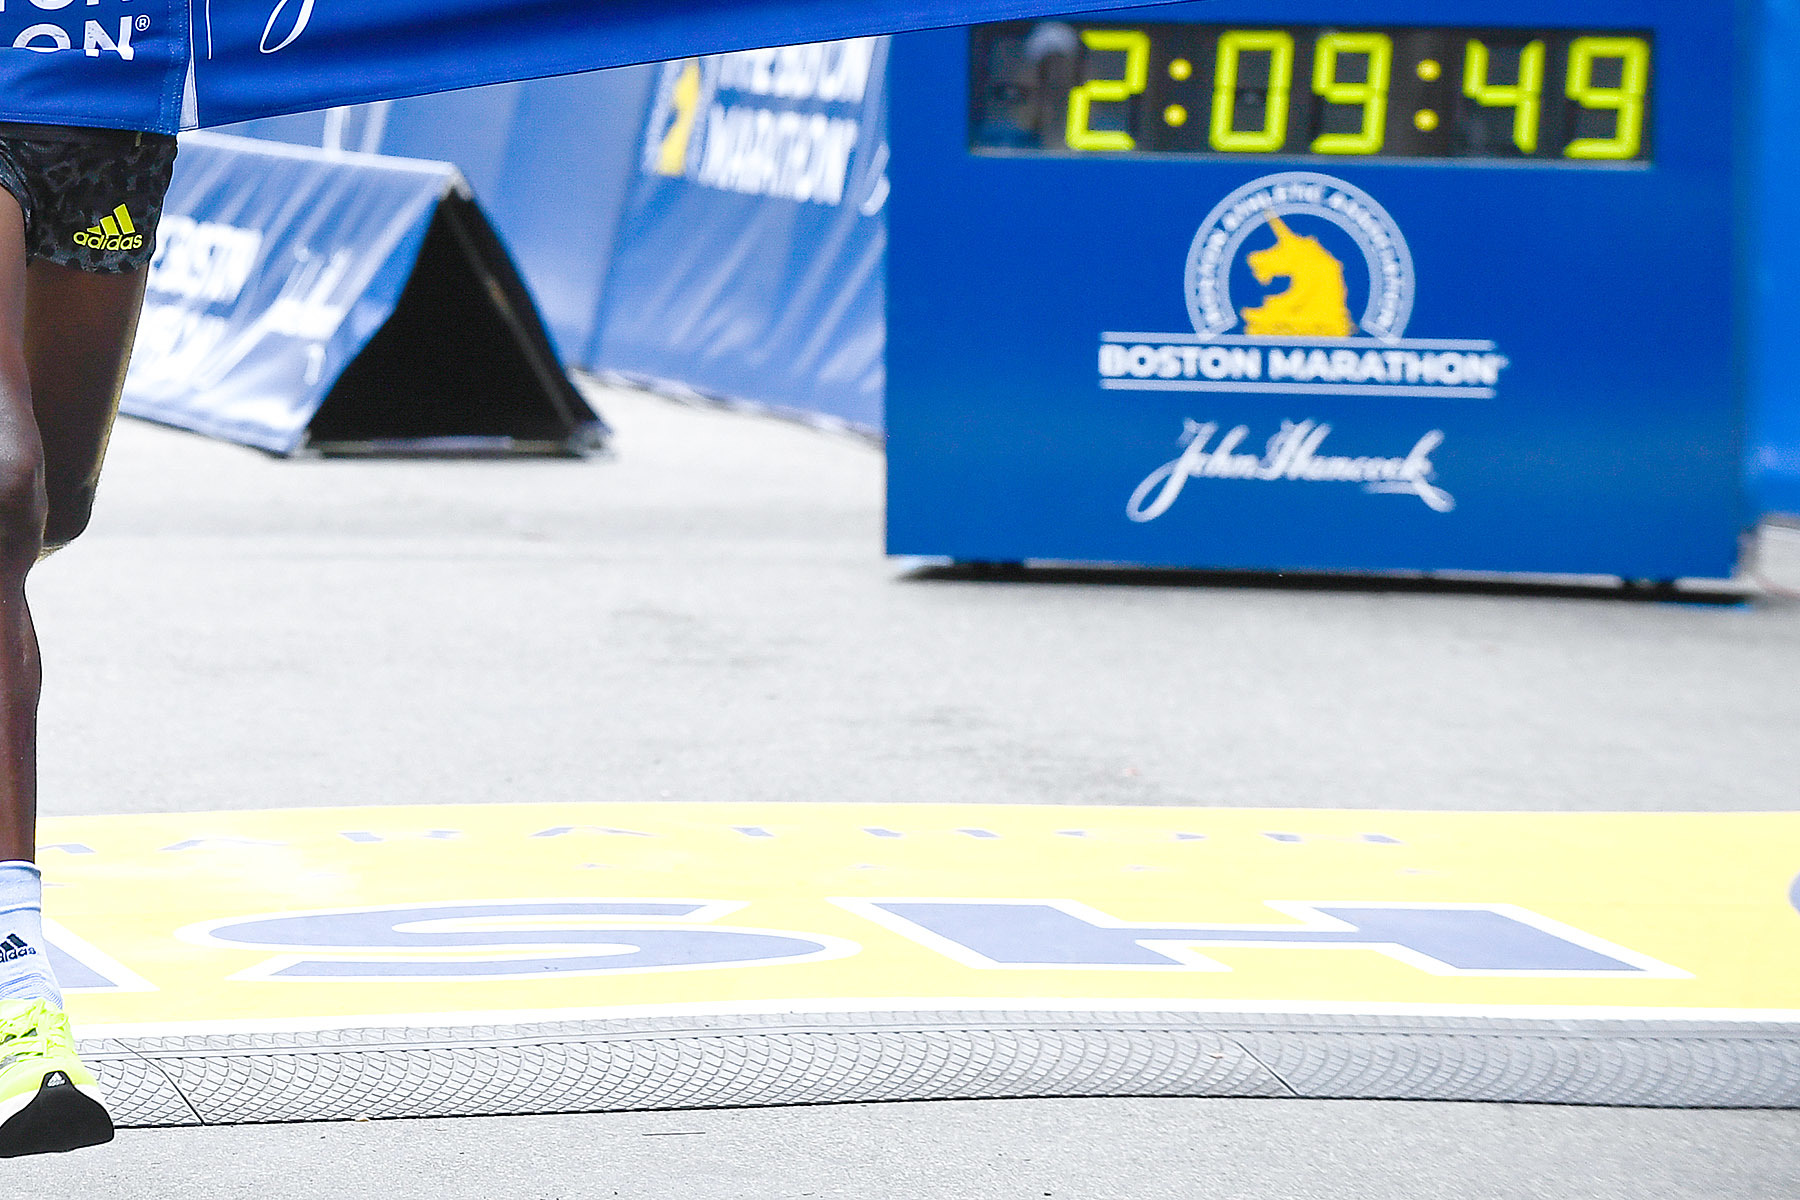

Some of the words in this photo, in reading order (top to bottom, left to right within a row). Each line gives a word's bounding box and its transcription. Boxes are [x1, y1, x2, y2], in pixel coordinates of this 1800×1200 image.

[1066, 29, 1650, 160] 2:09:49
[73, 231, 143, 251] adidas
[1099, 344, 1263, 381] BOSTON
[1268, 348, 1498, 386] MARATHON
[1125, 417, 1262, 522] John
